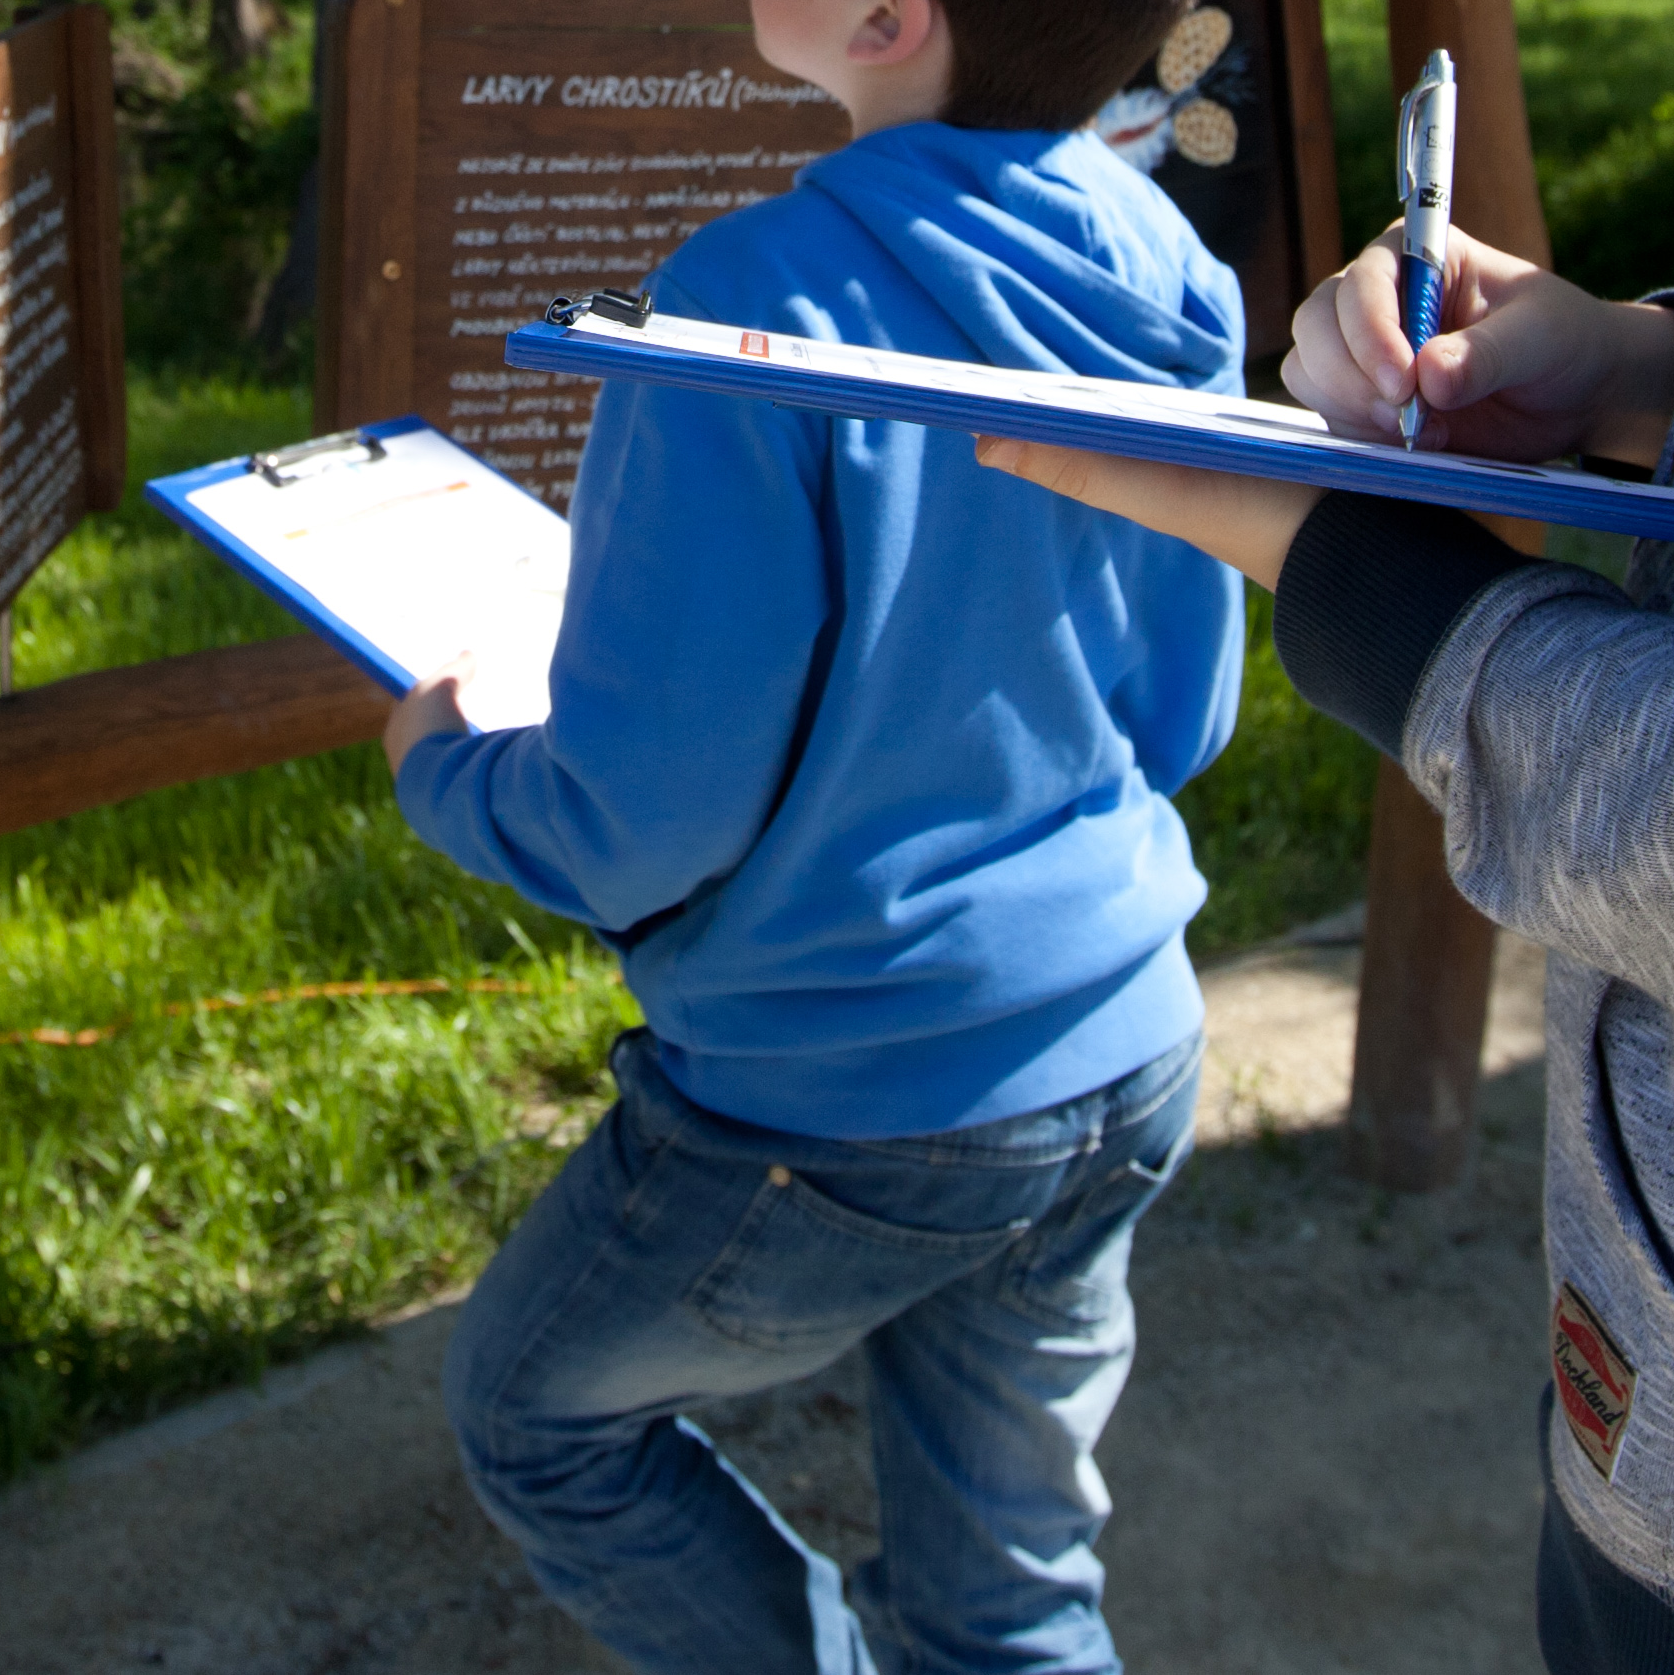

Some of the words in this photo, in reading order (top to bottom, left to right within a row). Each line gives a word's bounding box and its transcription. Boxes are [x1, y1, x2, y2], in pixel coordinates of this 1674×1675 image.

[461, 74, 553, 106] LARVY
[560, 67, 734, 110] CHROSTÍKŮ
[1553, 1331, 1624, 1426] Dockland
